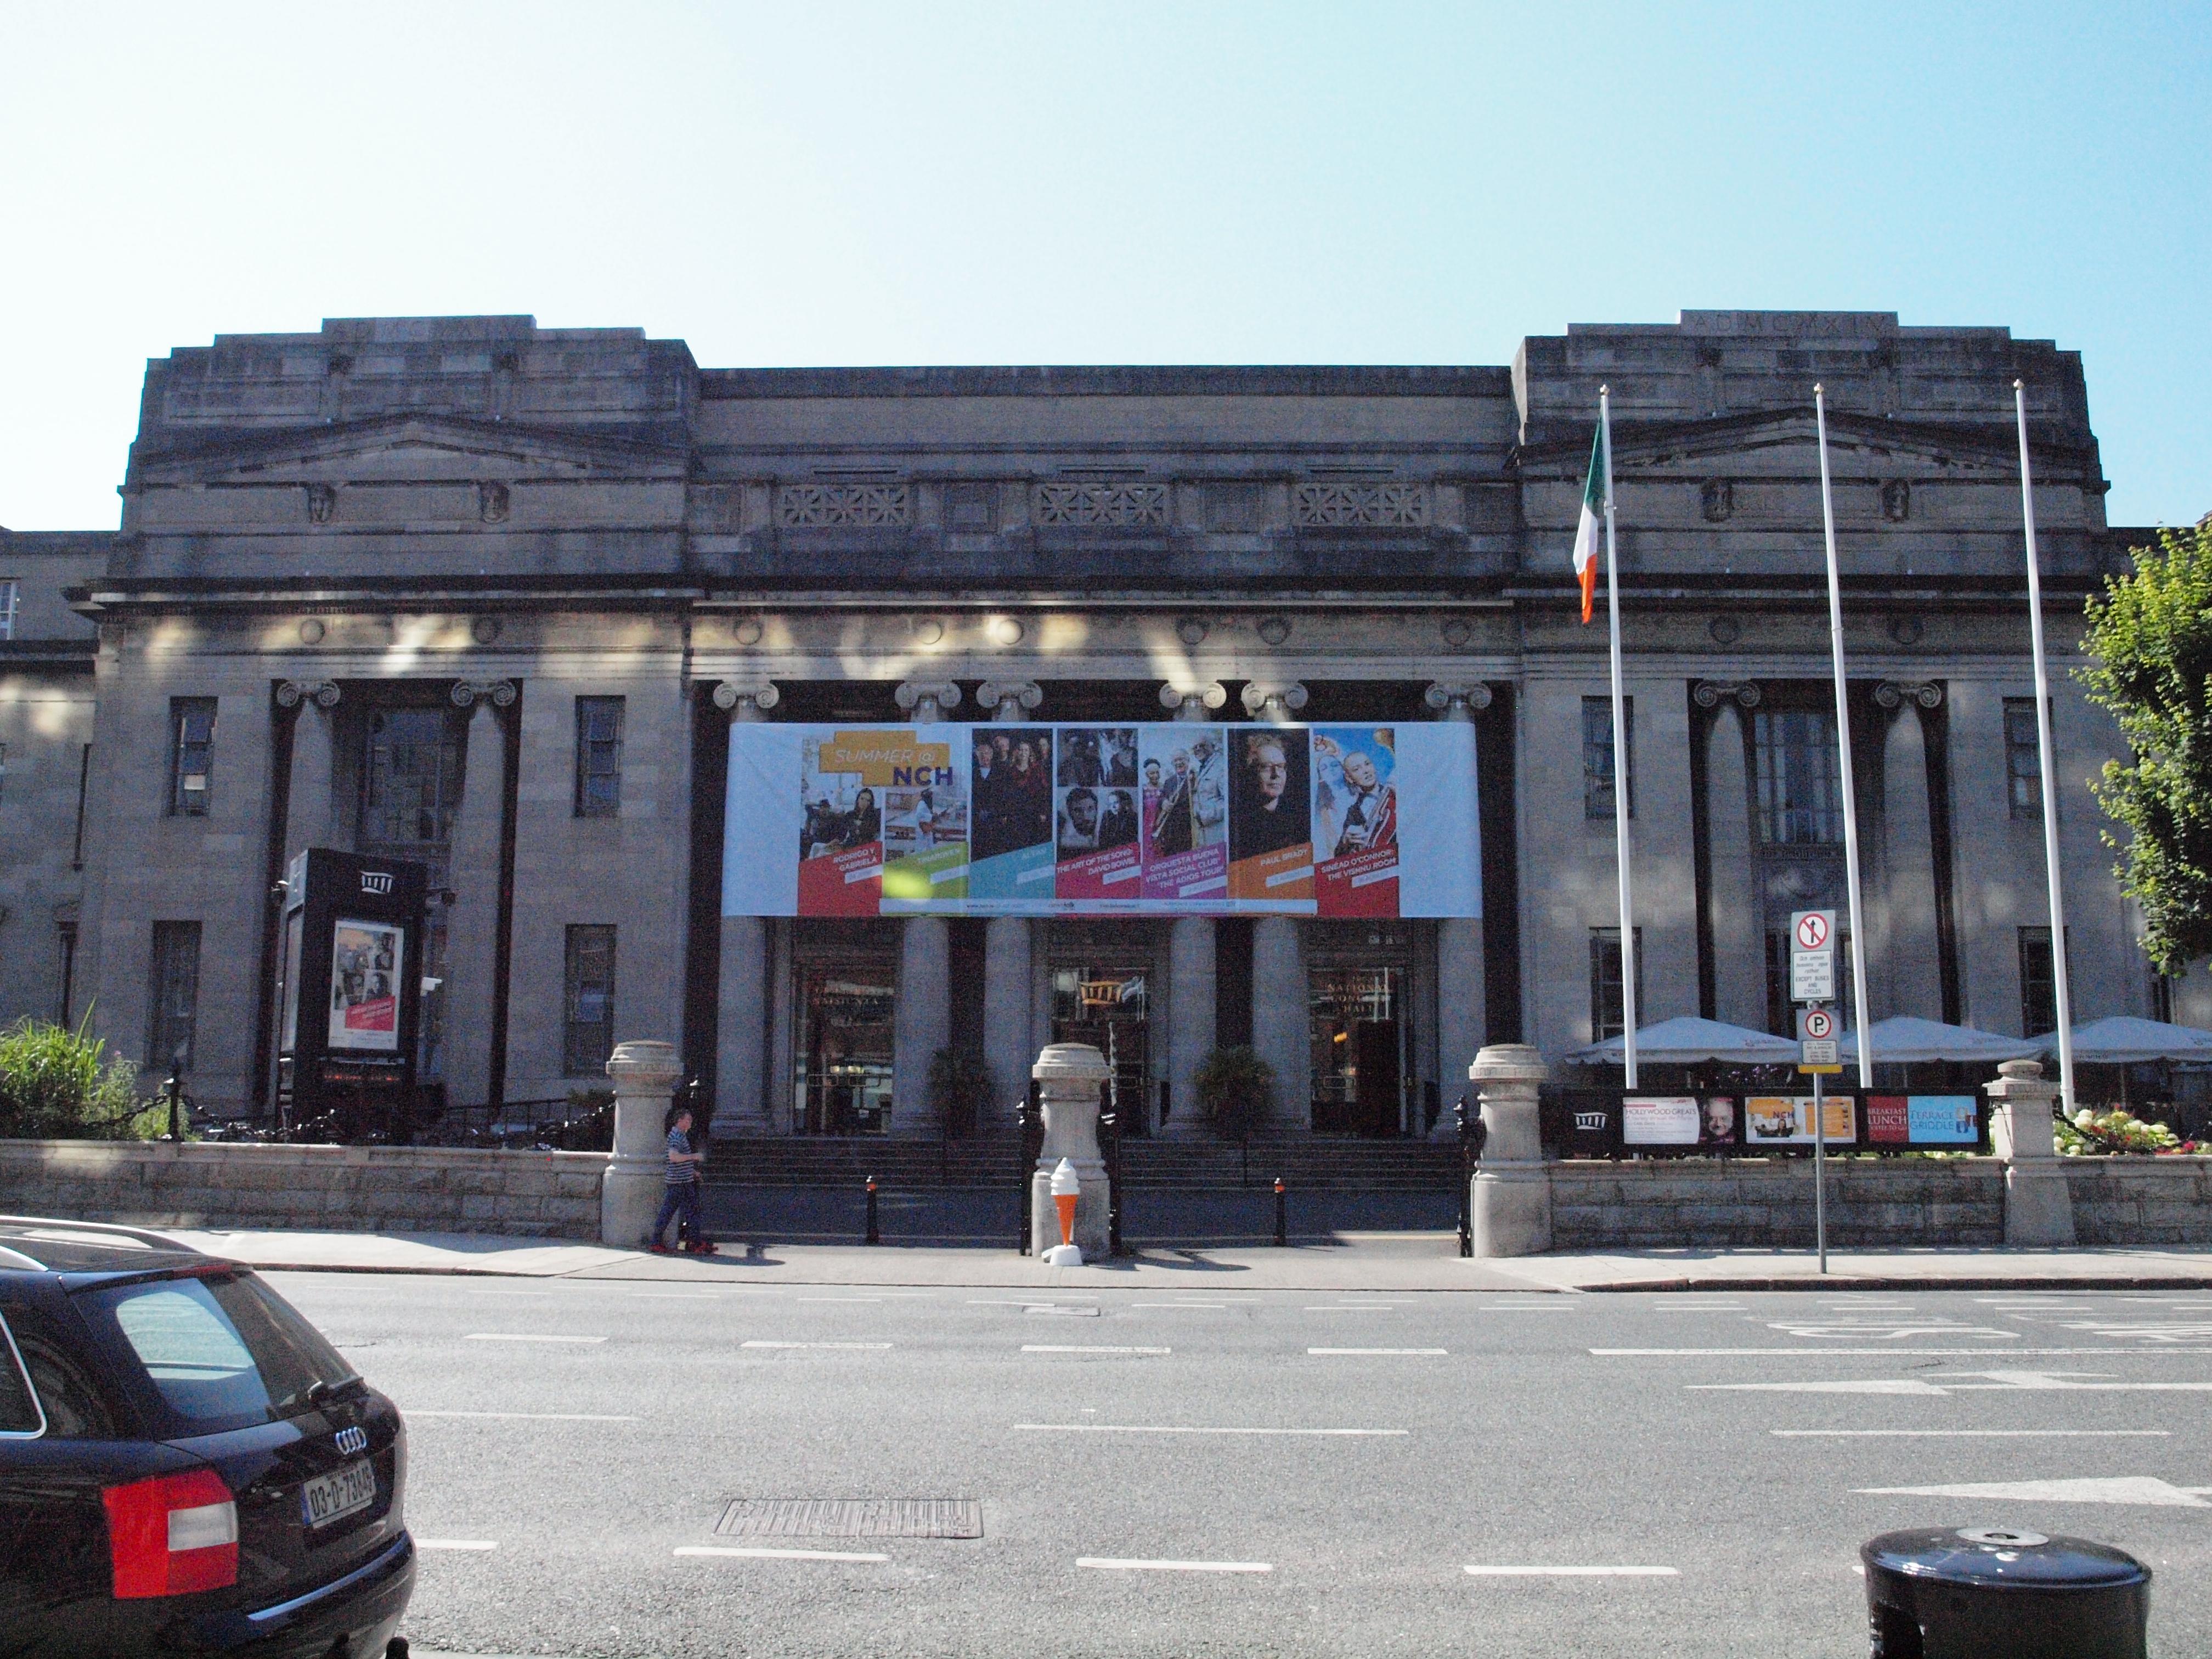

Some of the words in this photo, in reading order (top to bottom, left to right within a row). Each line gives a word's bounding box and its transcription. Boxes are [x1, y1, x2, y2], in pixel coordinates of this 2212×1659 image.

[836, 749, 915, 763] SUMMER
[918, 752, 935, 765] @
[893, 766, 953, 786] NCH
[833, 849, 868, 863] RODRIGO
[839, 857, 877, 871] GABRIELA
[1057, 865, 1070, 873] THE
[1071, 860, 1085, 870] ART
[1086, 858, 1096, 866] OF
[1097, 854, 1110, 864] THE
[1150, 856, 1191, 872] ORQUESTA
[1193, 849, 1219, 861] BUENA
[1261, 857, 1280, 866] PAUL
[1282, 849, 1308, 862] BRADY
[1088, 864, 1110, 875] DAVID
[1111, 857, 1136, 869] BOWIE
[1147, 872, 1167, 883] VISTA
[1169, 865, 1196, 877] SOCIAL
[1328, 871, 1343, 881] THE
[1373, 857, 1396, 869] ROOM
[1814, 1017, 1824, 1033] P
[1868, 1115, 1907, 1125] LUNCH
[1910, 1110, 1954, 1120] TERRACE
[1910, 1121, 1954, 1130] GRIDDLE
